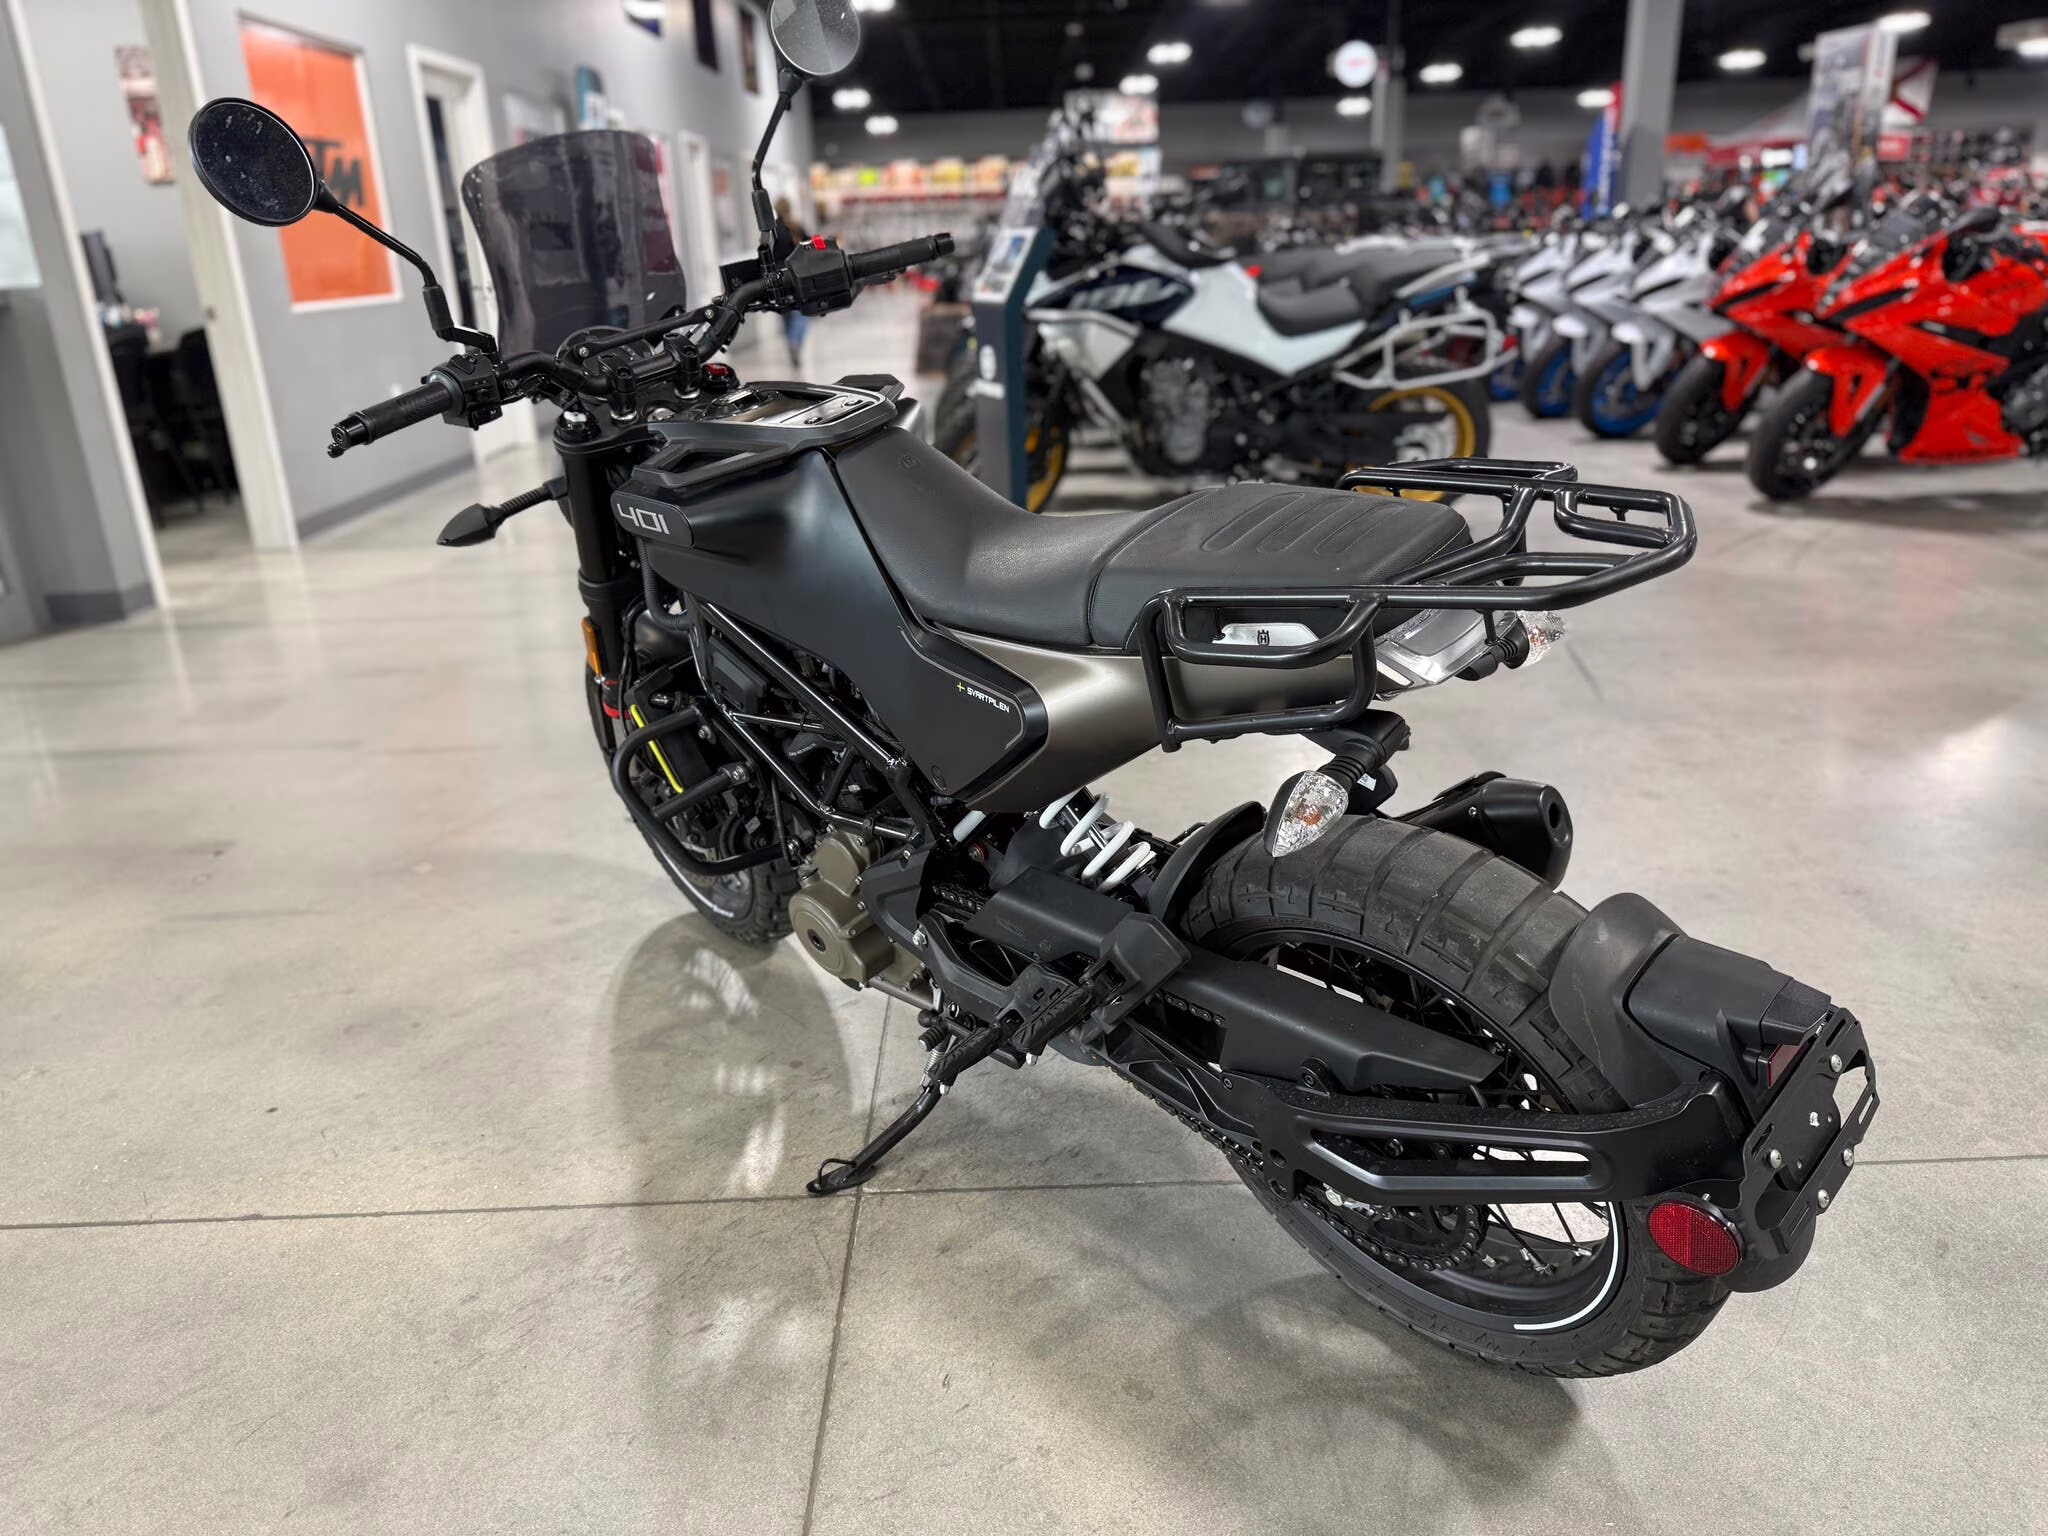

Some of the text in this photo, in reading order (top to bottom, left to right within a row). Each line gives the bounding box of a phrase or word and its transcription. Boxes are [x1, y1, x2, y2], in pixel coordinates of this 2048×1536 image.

[301, 137, 365, 207] TM
[616, 503, 670, 535] 401
[966, 686, 1010, 713] SVARTPILEN
